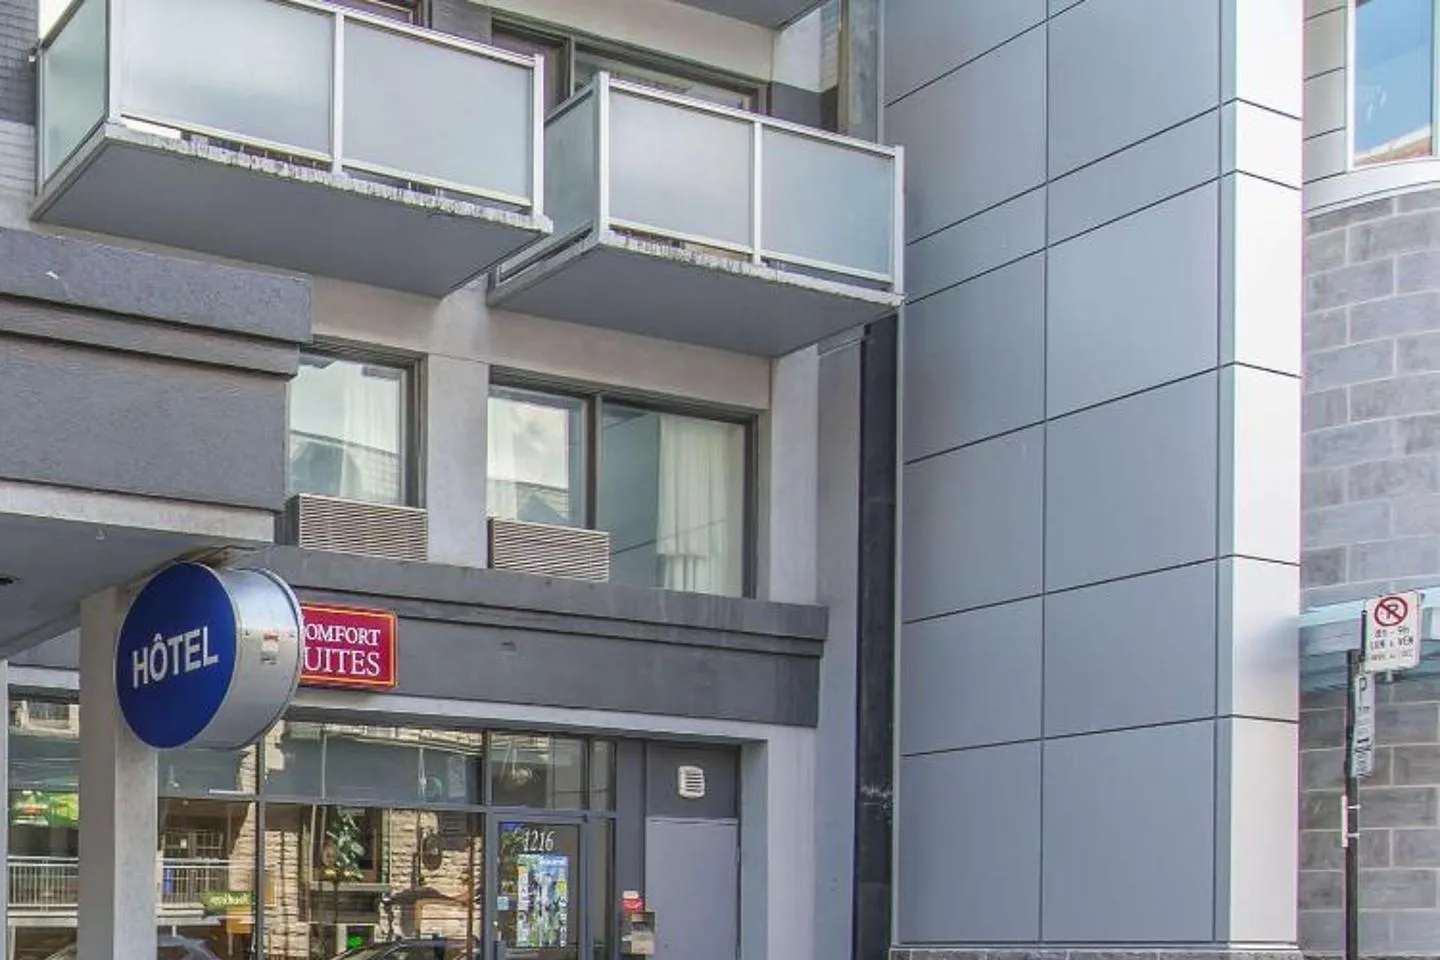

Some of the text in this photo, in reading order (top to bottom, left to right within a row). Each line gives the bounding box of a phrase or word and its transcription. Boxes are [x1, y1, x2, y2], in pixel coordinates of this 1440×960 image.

[304, 623, 382, 646] OMFORT
[131, 625, 220, 689] HÔTEL
[304, 646, 380, 677] UITES
[523, 829, 555, 852] 1216
